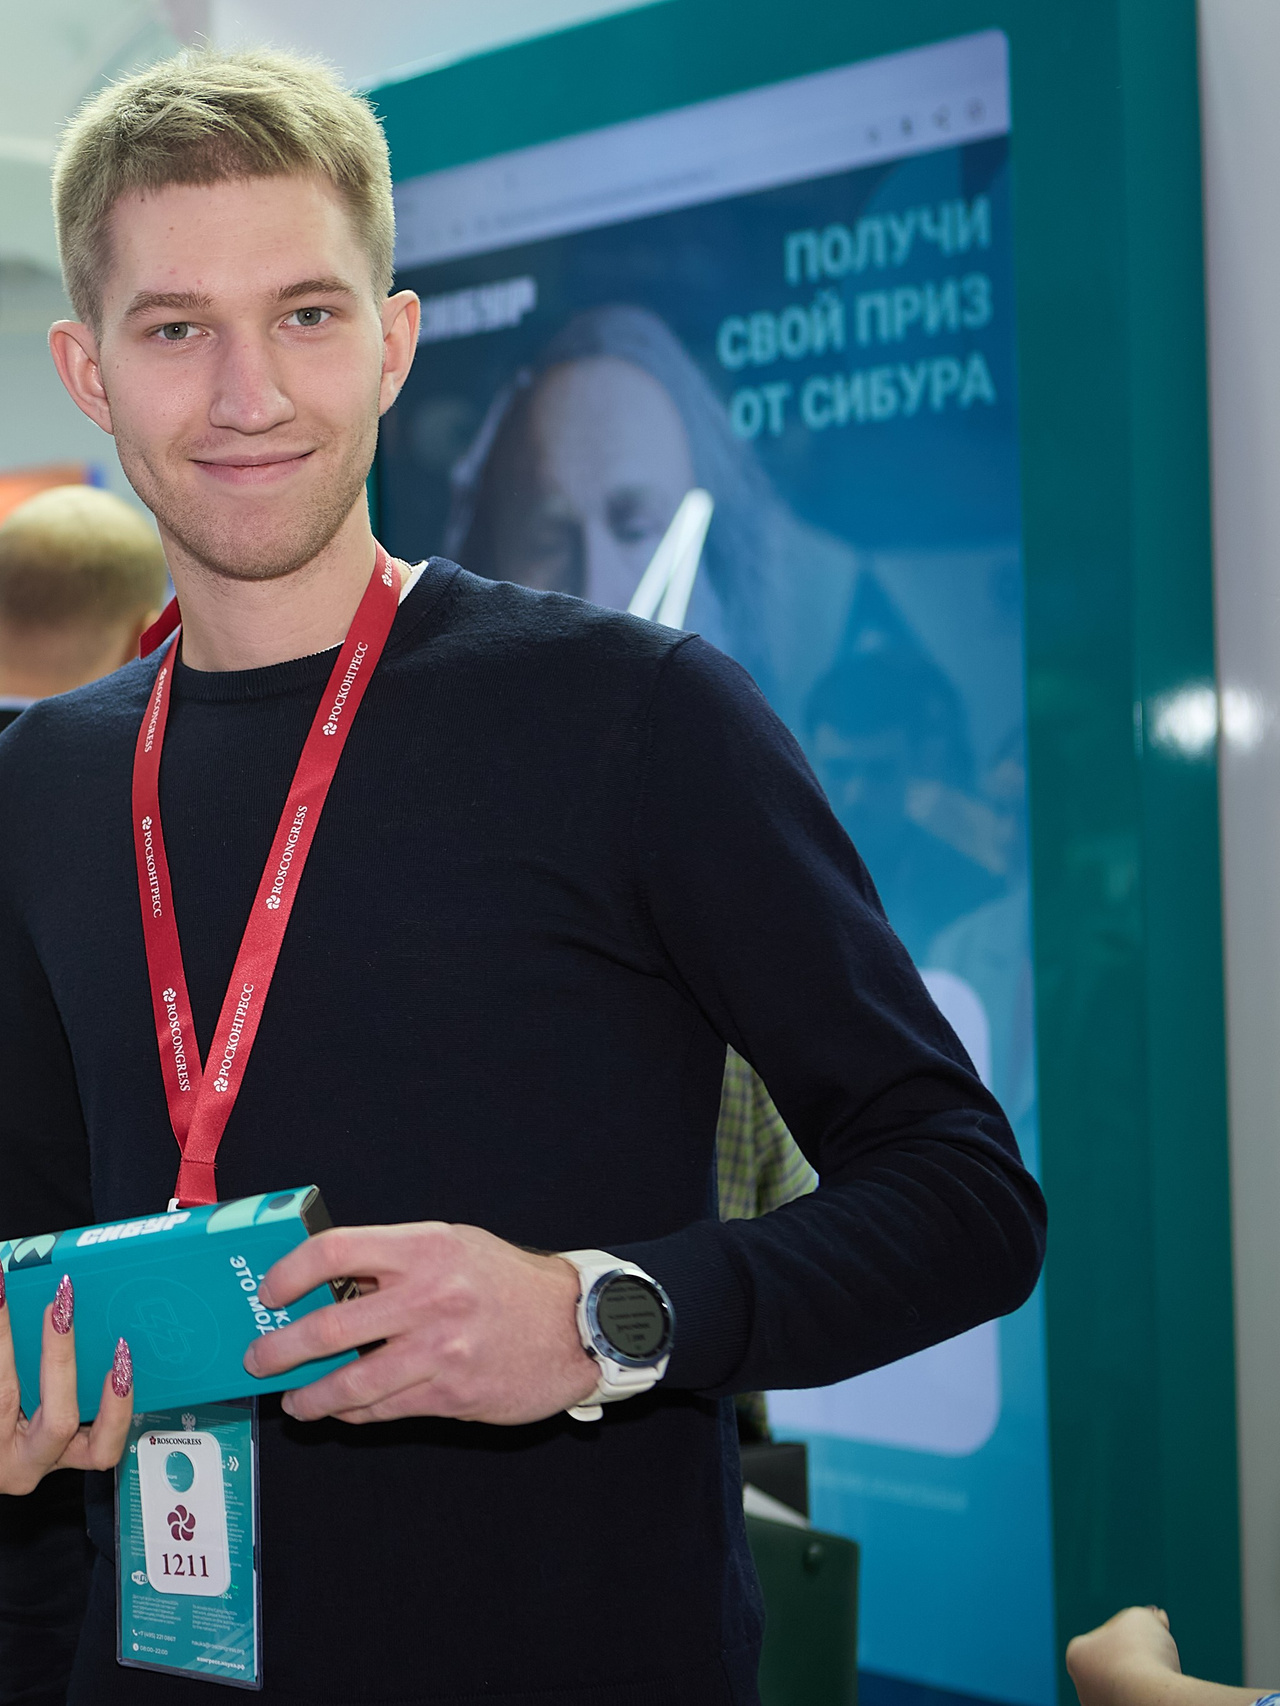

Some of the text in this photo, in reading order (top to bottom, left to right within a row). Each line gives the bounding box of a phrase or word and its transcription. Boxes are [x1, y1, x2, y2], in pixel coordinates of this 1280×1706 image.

[784, 194, 991, 287] ПОЛУЧИ
[716, 272, 993, 370] СВОЙ ПРИЗ
[729, 352, 996, 440] ОТ СИБУРА
[328, 642, 368, 723] РОСКОНГРЕСС
[144, 830, 162, 918] РОСКОНГРЕСС
[272, 805, 308, 895] ROSCONGRESS
[166, 1003, 191, 1092] ROSCONGRESS
[219, 983, 254, 1077] РОСКОНГРЕСС
[76, 1211, 191, 1247] СИБУР
[230, 1255, 257, 1292] ЭТО
[156, 1437, 202, 1446] ROSCONGRESS
[162, 1553, 209, 1578] 1211
